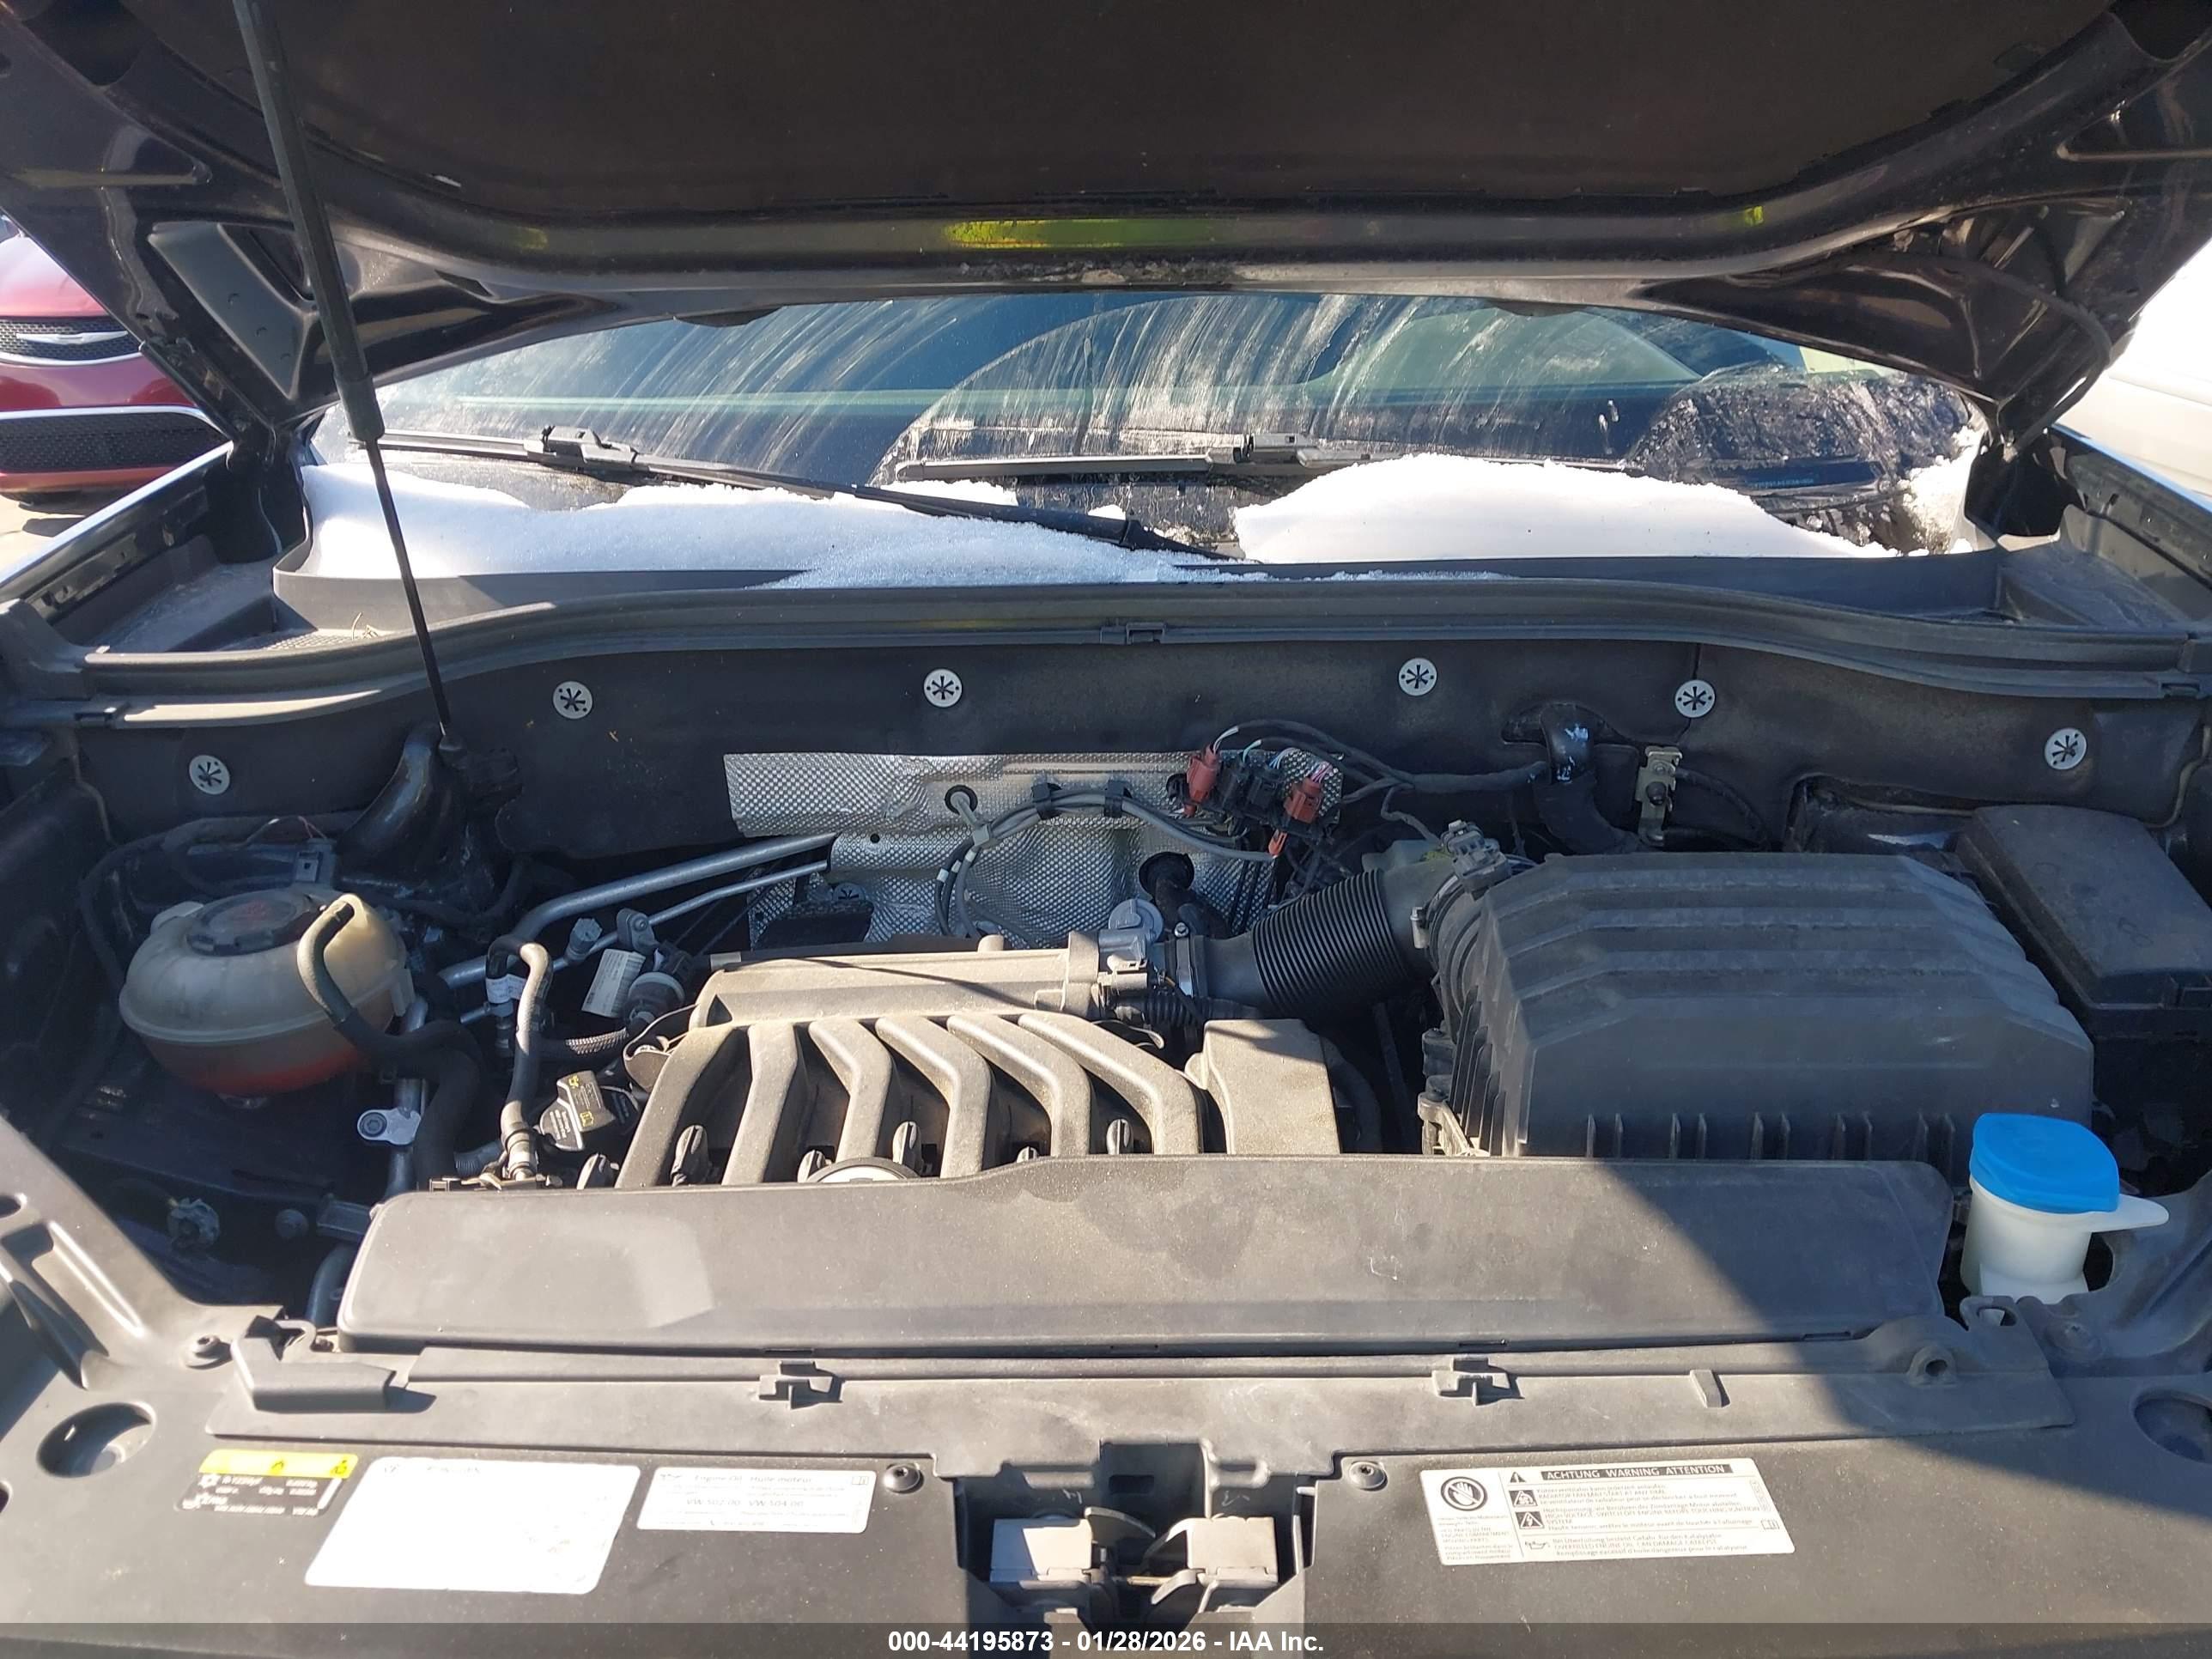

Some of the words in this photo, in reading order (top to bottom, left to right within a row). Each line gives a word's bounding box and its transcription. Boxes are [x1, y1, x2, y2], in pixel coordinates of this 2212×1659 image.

[1547, 1469, 1601, 1480] ACHTUNG
[1605, 1468, 1661, 1478] WARNING
[1665, 1465, 1725, 1475] ATTENTION
